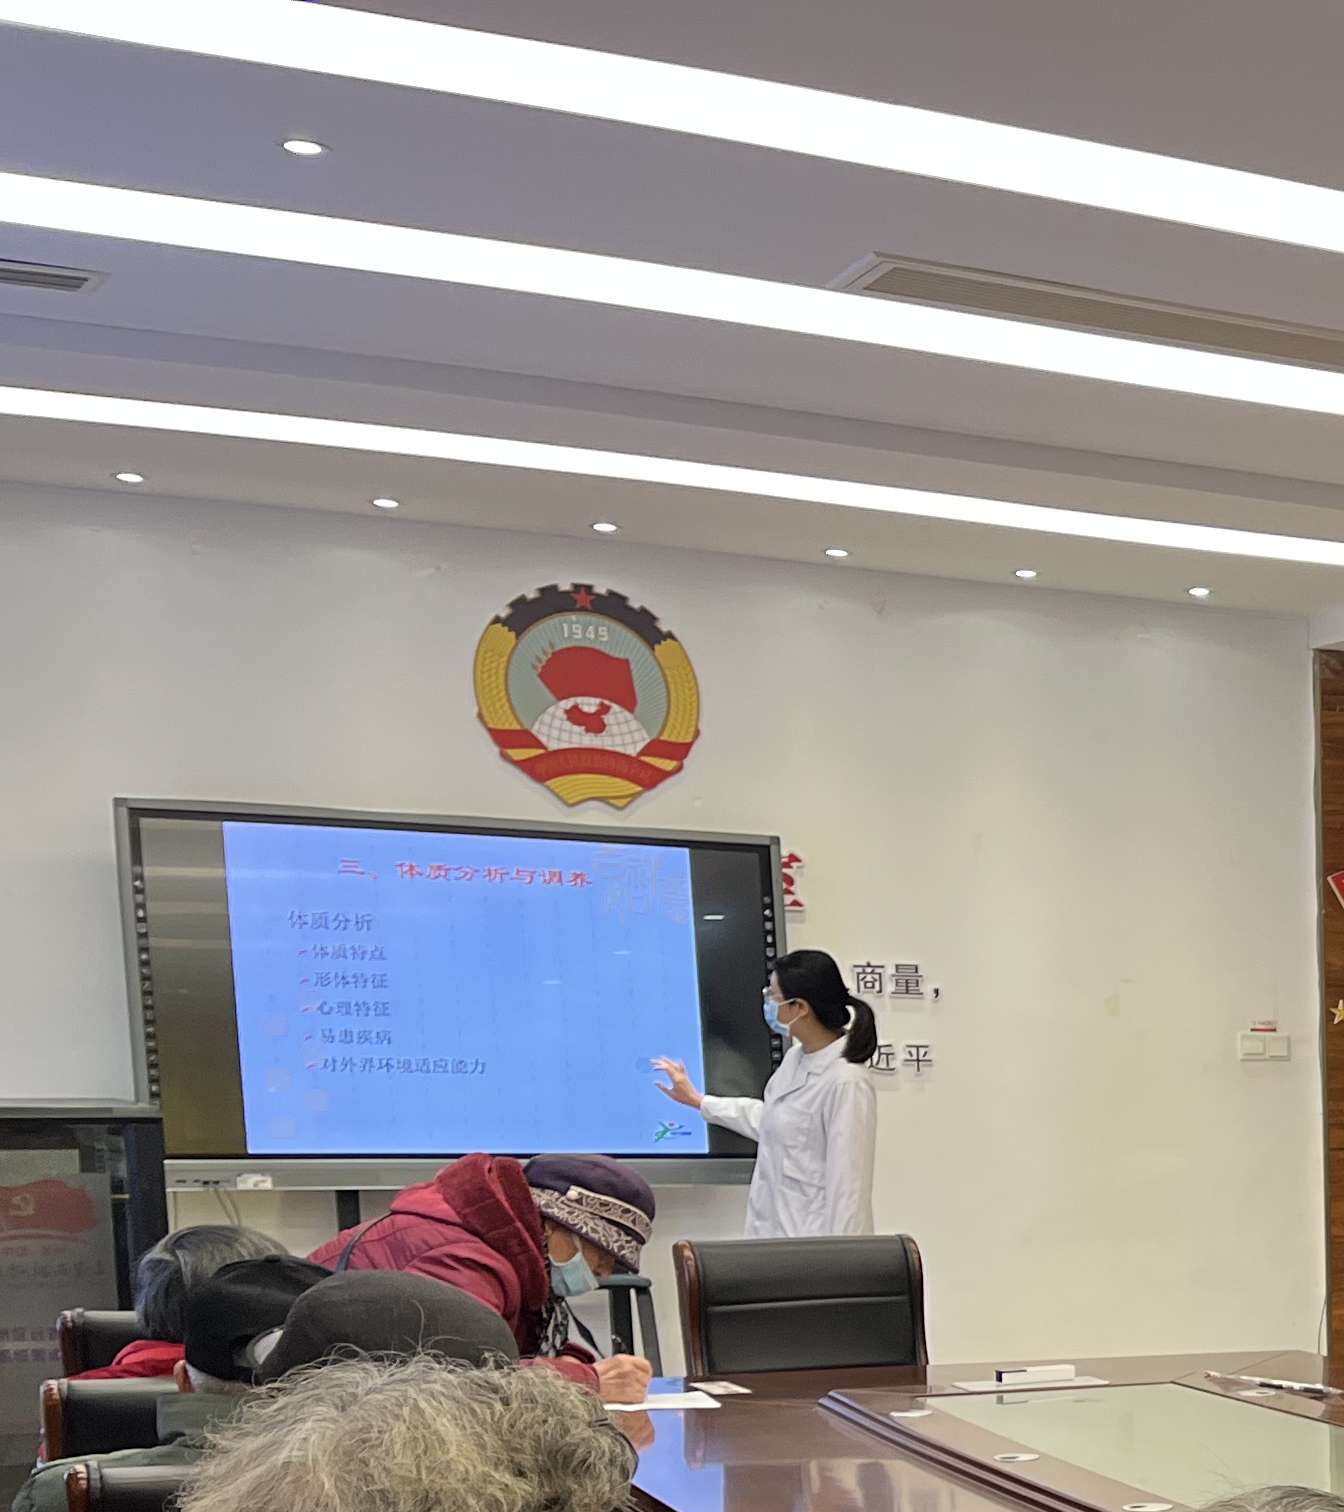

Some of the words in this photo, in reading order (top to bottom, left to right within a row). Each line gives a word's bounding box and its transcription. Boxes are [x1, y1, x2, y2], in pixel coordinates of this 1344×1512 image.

[562, 623, 609, 642] 1949
[337, 858, 594, 888] 三、体质分析与调养
[288, 910, 374, 933] 体质分析
[311, 943, 388, 961] 体质特点
[313, 972, 389, 989] 形体特征
[316, 1000, 391, 1017] 心理特征
[319, 1028, 392, 1046] 易患疾病
[320, 1056, 487, 1075] 对外界环境适应能力
